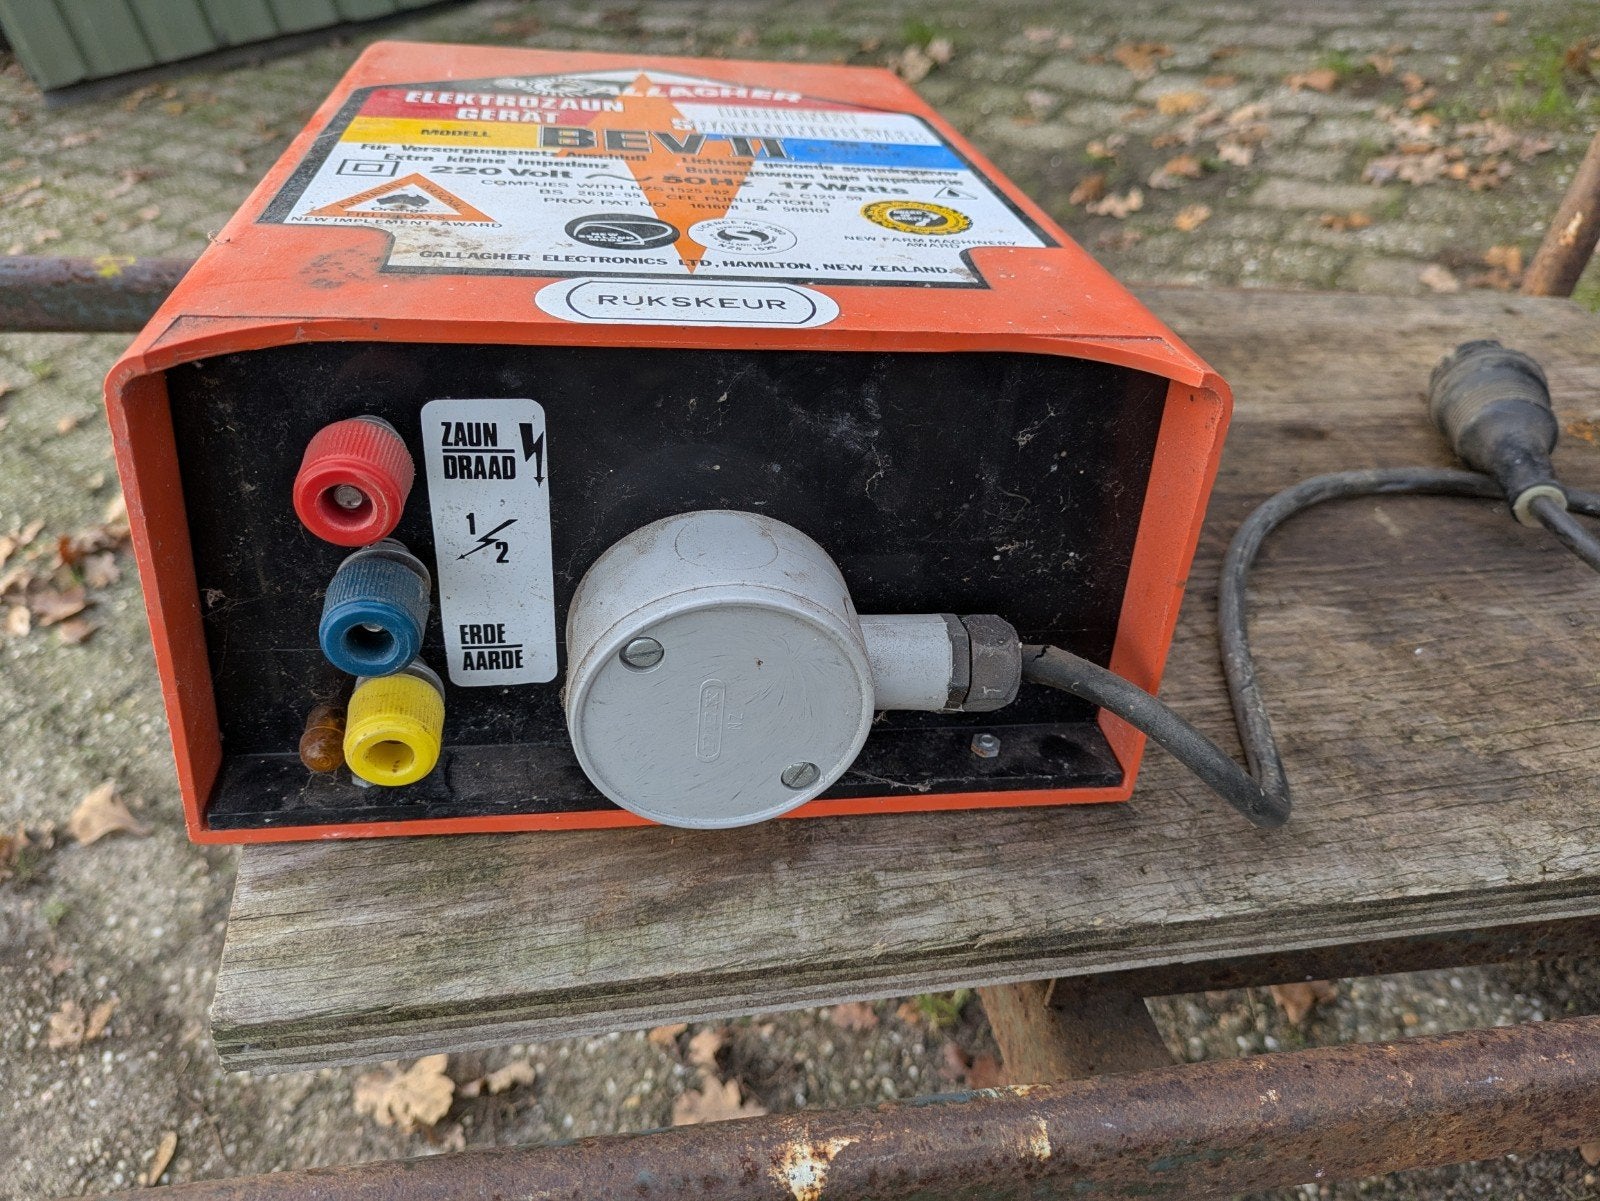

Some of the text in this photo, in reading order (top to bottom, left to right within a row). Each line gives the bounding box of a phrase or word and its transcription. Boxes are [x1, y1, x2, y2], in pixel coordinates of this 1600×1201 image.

[404, 90, 624, 113] ELEKTROZAUN
[456, 106, 558, 124] GERÄT
[420, 128, 492, 138] MODELL
[540, 126, 708, 156] BEV
[384, 153, 610, 169] Extra kleine Impedanz
[401, 145, 558, 158] Versorgungsnetz
[429, 165, 503, 176] 220
[508, 168, 573, 179] Volt
[778, 181, 812, 192] 17
[815, 183, 910, 196] Watts
[685, 166, 963, 187] Buitengewoon lage impedantie
[481, 179, 569, 188] COMPLIES
[577, 183, 624, 191] WITH
[769, 191, 791, 199] AS
[539, 188, 564, 196] BS
[704, 195, 814, 207] PUBLICATION
[334, 217, 431, 226] IMPLEMENT
[440, 221, 503, 229] AWARD
[401, 212, 446, 220] DAYS
[928, 239, 1017, 247] MACHINERY
[419, 250, 531, 261] GALLAGHER
[542, 254, 668, 266] ELECTRONICS
[824, 263, 863, 272] NEW
[441, 421, 498, 447] ZAUN
[443, 455, 516, 480] DRAAD
[466, 512, 476, 535] 1
[495, 541, 510, 564] 2
[459, 623, 507, 645] ERDE
[462, 649, 524, 671] AARDE
